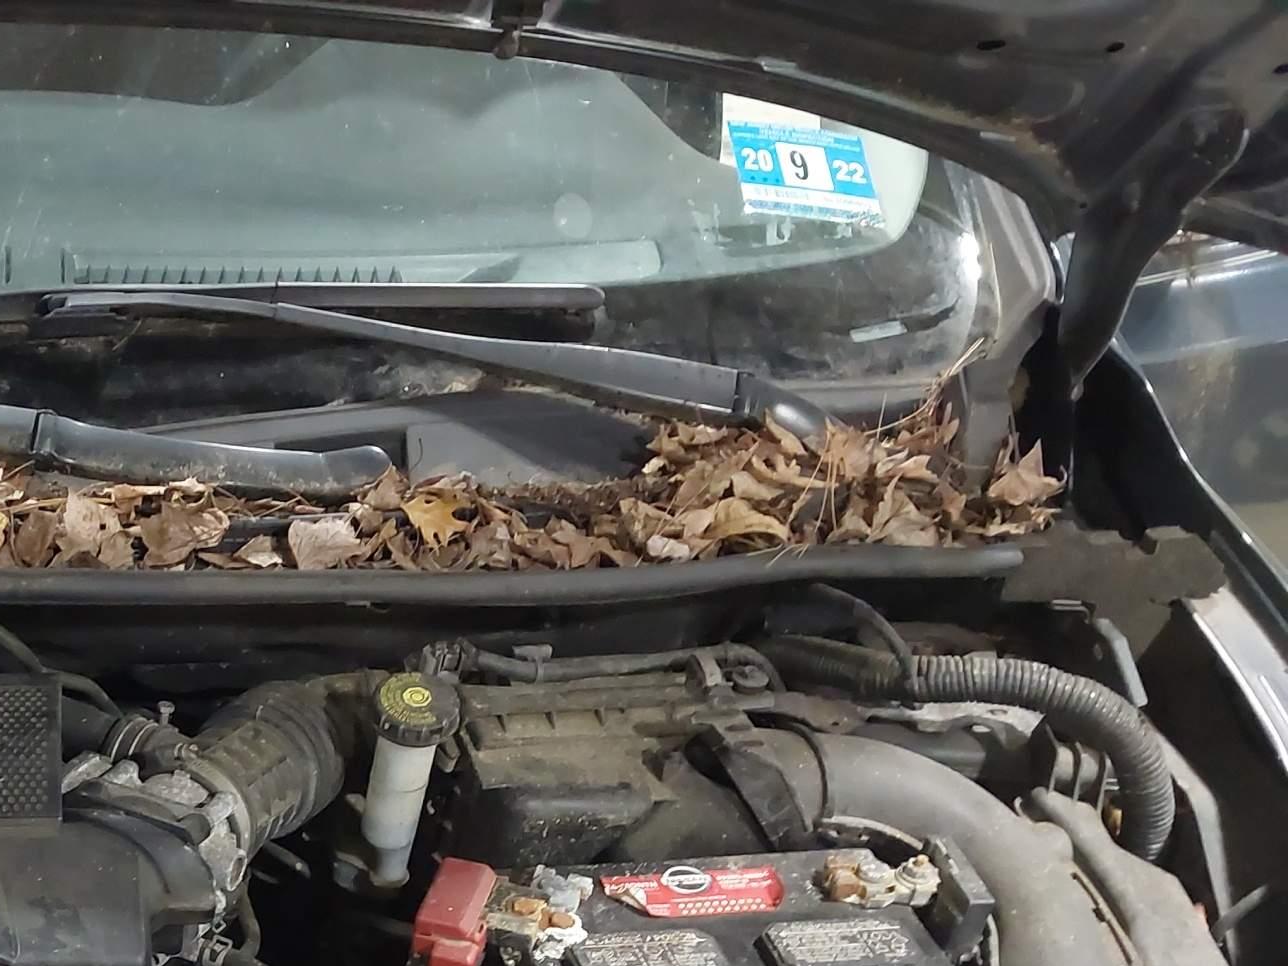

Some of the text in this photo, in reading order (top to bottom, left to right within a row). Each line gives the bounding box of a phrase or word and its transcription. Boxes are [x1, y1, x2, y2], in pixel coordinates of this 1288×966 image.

[741, 148, 867, 184] 20 9 22
